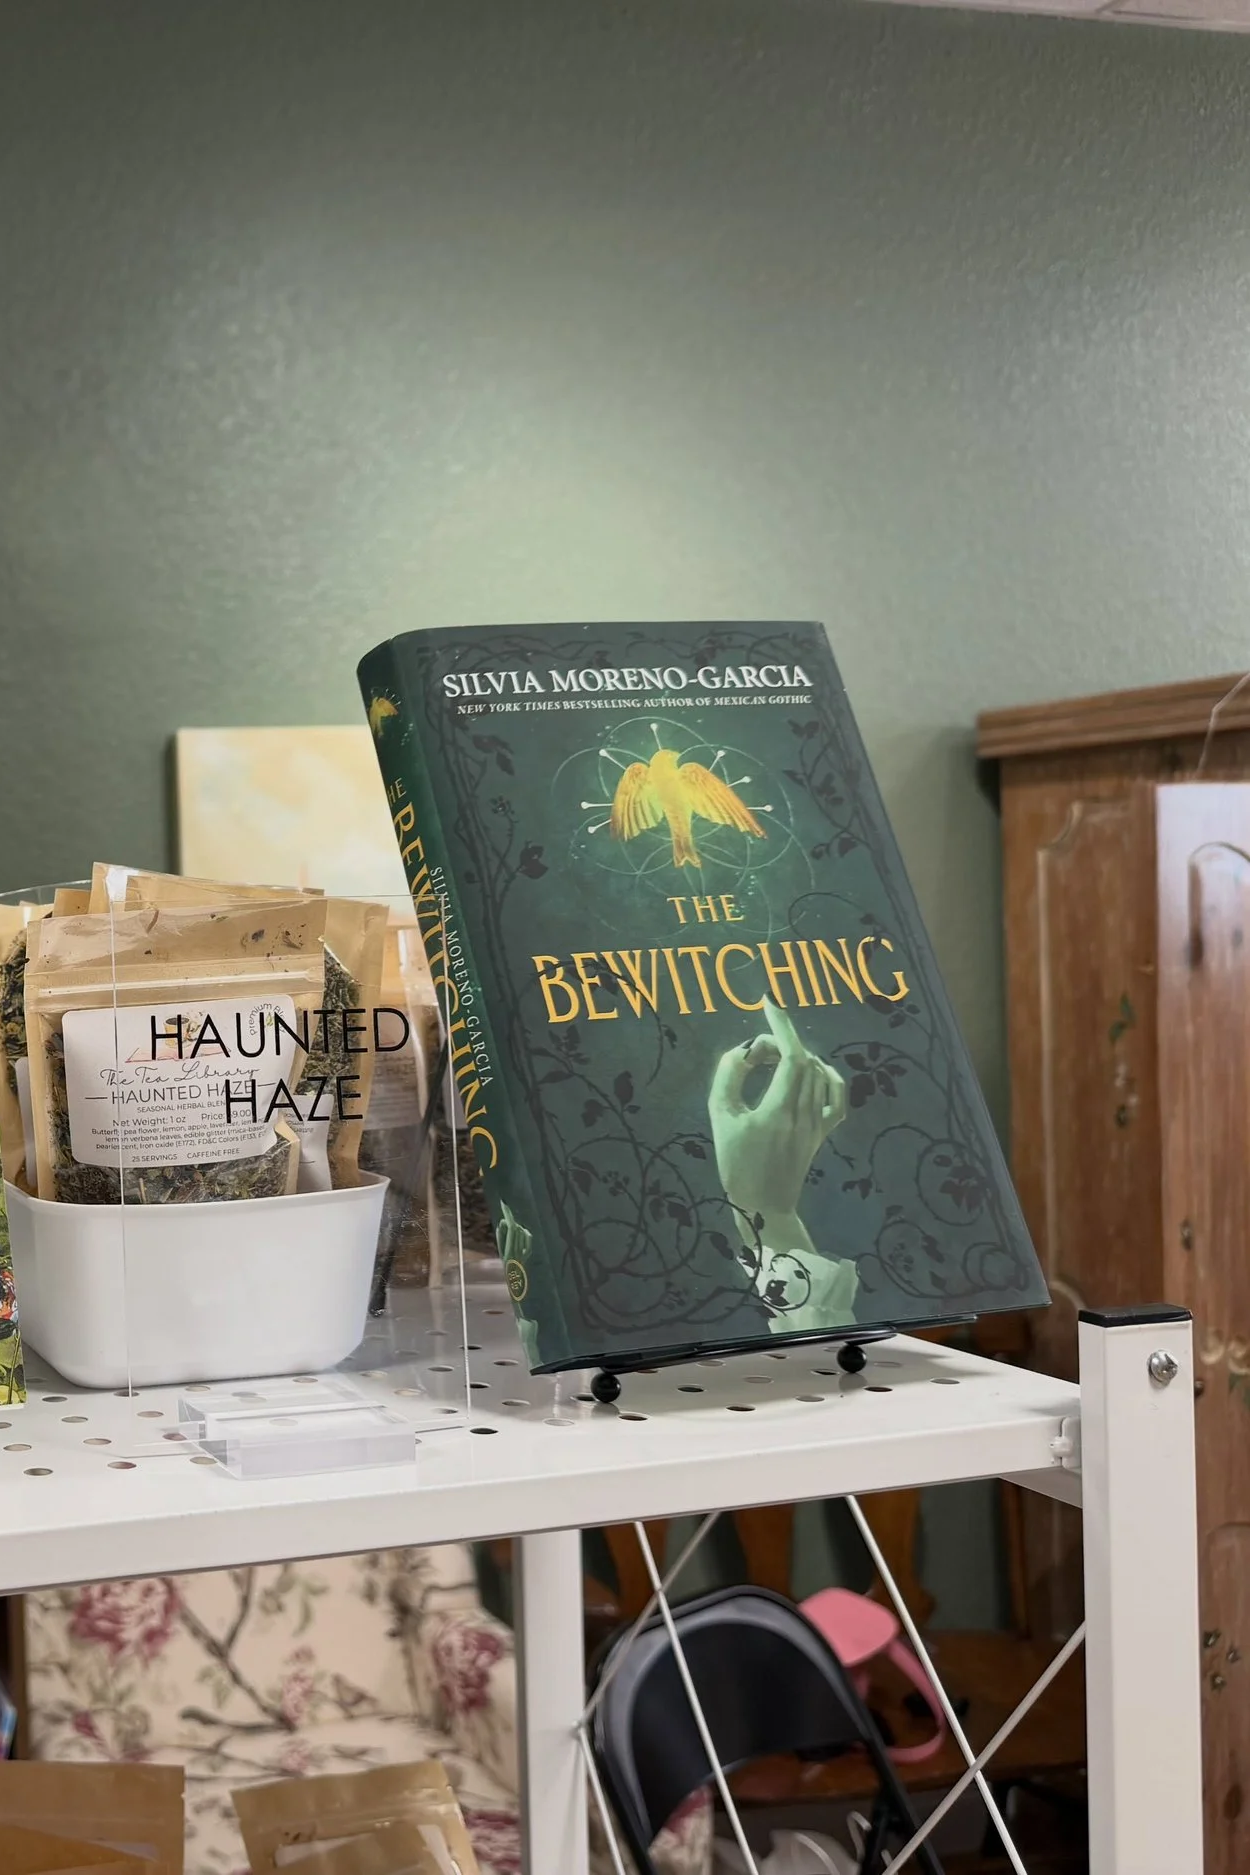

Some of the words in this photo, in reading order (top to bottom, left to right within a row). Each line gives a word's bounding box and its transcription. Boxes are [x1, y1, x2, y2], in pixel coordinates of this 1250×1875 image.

[442, 673, 545, 698] SILVIA
[549, 665, 814, 693] MORENO-GARCIA
[457, 705, 486, 715] NEW
[489, 703, 521, 713] YORK
[524, 701, 561, 712] TIMES
[563, 699, 640, 710] BESTSELLING
[643, 697, 694, 708] AUTHOR
[695, 697, 713, 706] OF
[714, 695, 766, 706] MEXICAN
[768, 694, 812, 704] GOTHIC
[388, 778, 407, 806] HE
[430, 866, 453, 923] SILVIA
[667, 894, 745, 924] THE
[532, 936, 910, 1023] BEWITCHING
[443, 930, 494, 1087] MORENO-GARCIA
[150, 1007, 410, 1060] HAUNTED
[100, 1068, 134, 1086] The
[135, 1066, 169, 1084] Tea
[174, 1061, 260, 1081] Library
[112, 1085, 201, 1104] HAUNTED
[207, 1080, 253, 1097] HAZE
[225, 1074, 363, 1124] HAZE
[137, 1103, 175, 1113] SEASONAL
[177, 1101, 205, 1111] HERBAL
[207, 1100, 227, 1108] BLEN
[228, 1109, 251, 1118] 9.00
[113, 1119, 130, 1127] Net
[132, 1116, 168, 1127] Weight:
[170, 1116, 174, 1124] 1
[138, 1126, 162, 1134] flower,
[187, 1123, 209, 1132] apple,
[130, 1134, 158, 1142] verbena
[184, 1130, 205, 1138] edible
[207, 1128, 226, 1138] glitter
[155, 1139, 174, 1147] oxide
[199, 1135, 217, 1144] FD&C
[218, 1132, 239, 1142] Colors
[142, 1153, 178, 1162] SERVINGS
[187, 1149, 221, 1159] CAFFEINE
[223, 1147, 240, 1155] FREE
